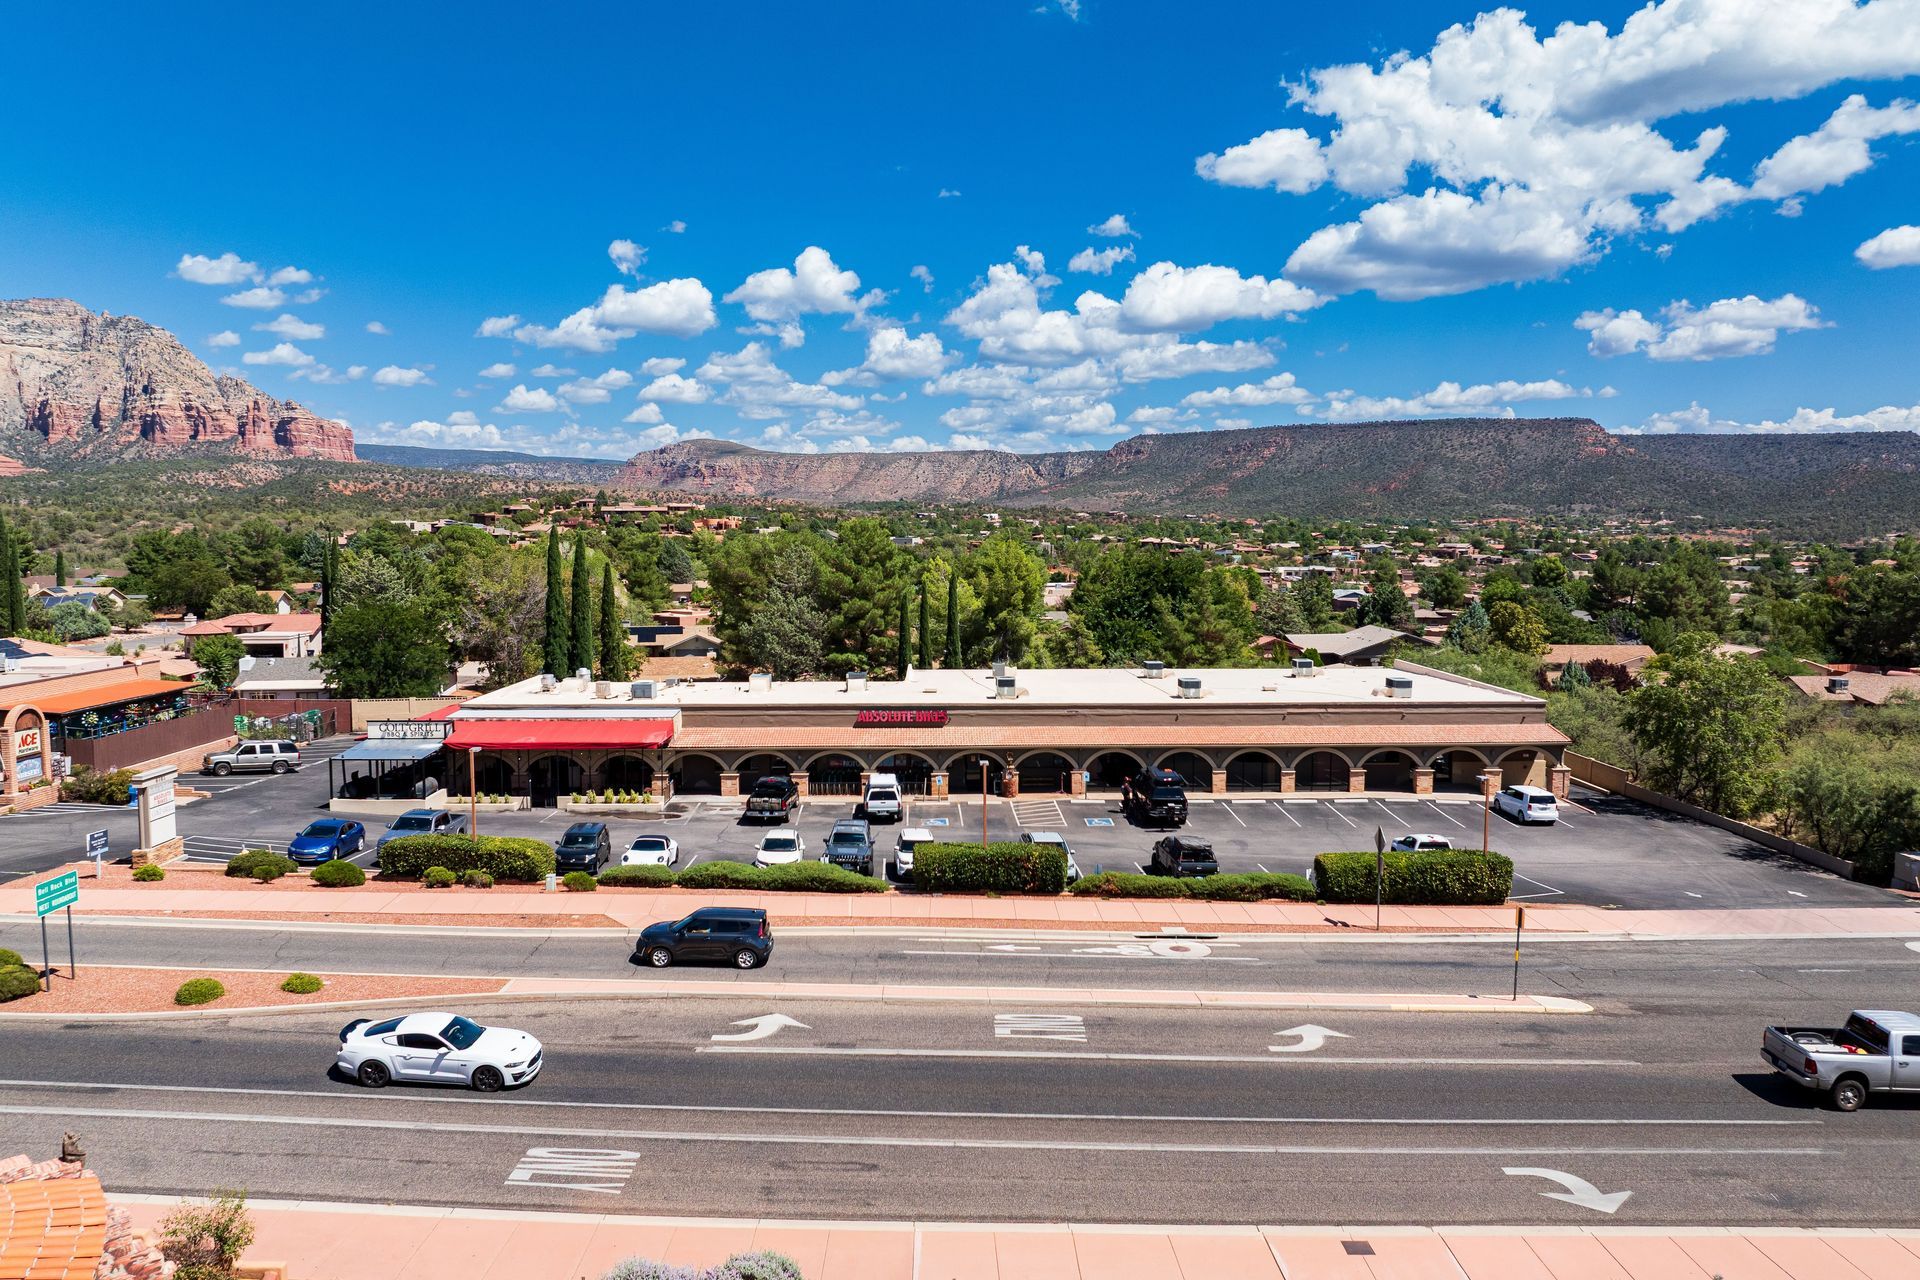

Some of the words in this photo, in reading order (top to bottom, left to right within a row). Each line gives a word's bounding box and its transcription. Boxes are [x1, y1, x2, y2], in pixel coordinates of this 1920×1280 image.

[858, 710, 913, 722] ABSOLUTE
[915, 710, 948, 722] BIKES
[379, 722, 406, 732] COLT
[409, 722, 440, 732] GRILL
[18, 732, 38, 748] ACE
[50, 881, 63, 891] Rock
[64, 876, 76, 886] Blvd
[994, 1014, 1088, 1042] ONLY
[503, 1147, 641, 1194] ONLY
